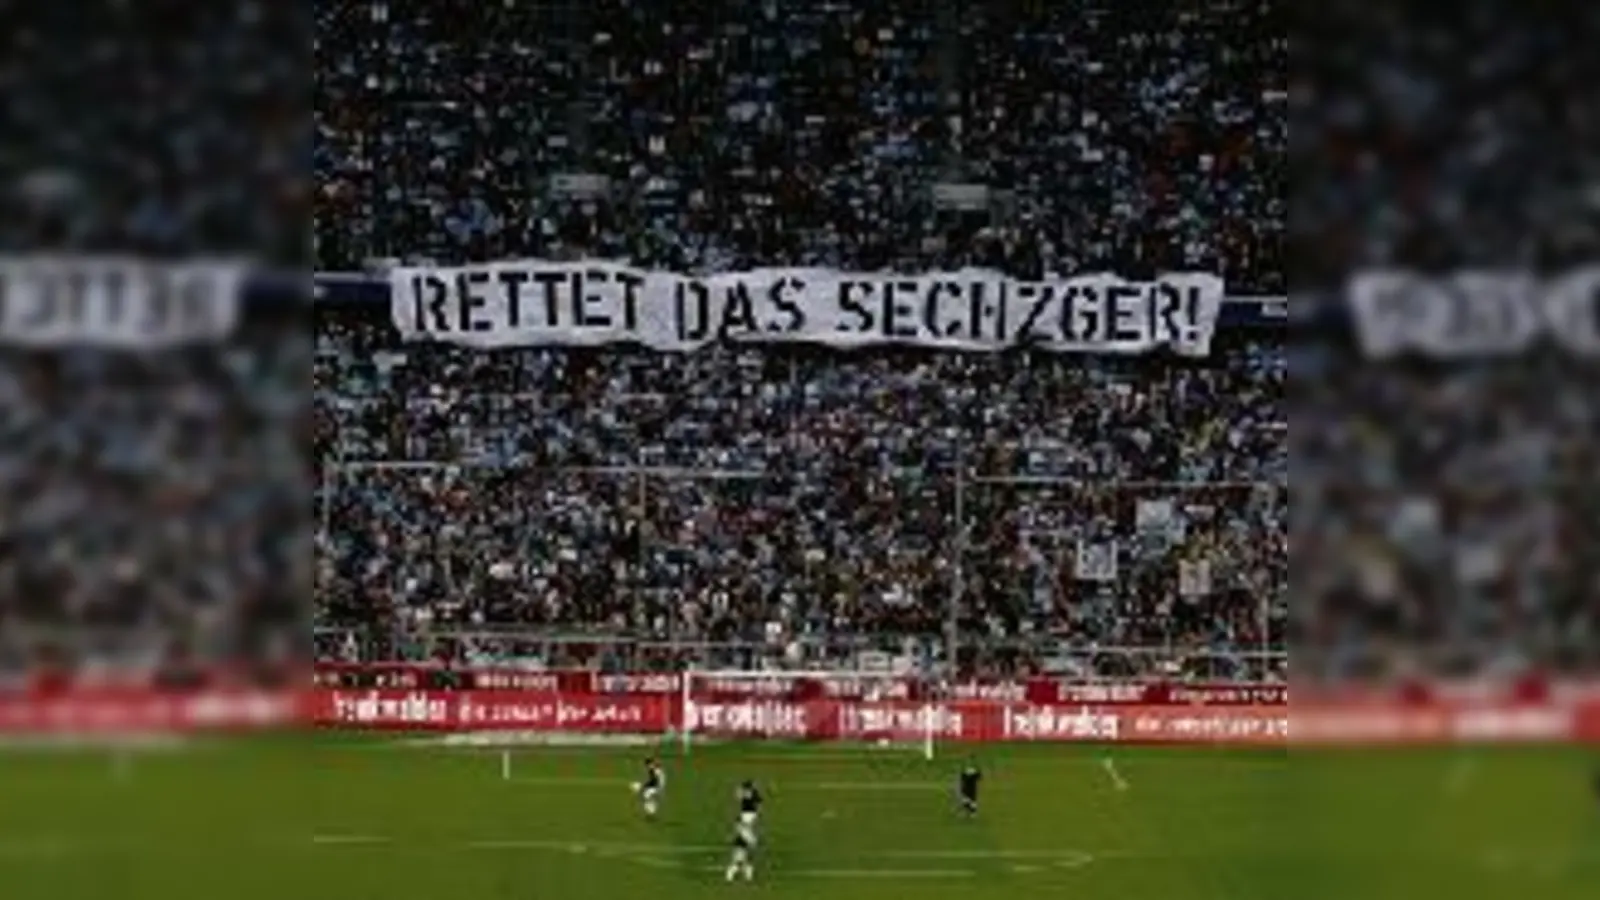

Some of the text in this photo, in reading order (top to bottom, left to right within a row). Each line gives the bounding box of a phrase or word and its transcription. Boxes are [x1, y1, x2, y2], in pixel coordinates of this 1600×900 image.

[412, 271, 1201, 342] RETTET DAS SECHZGER!
